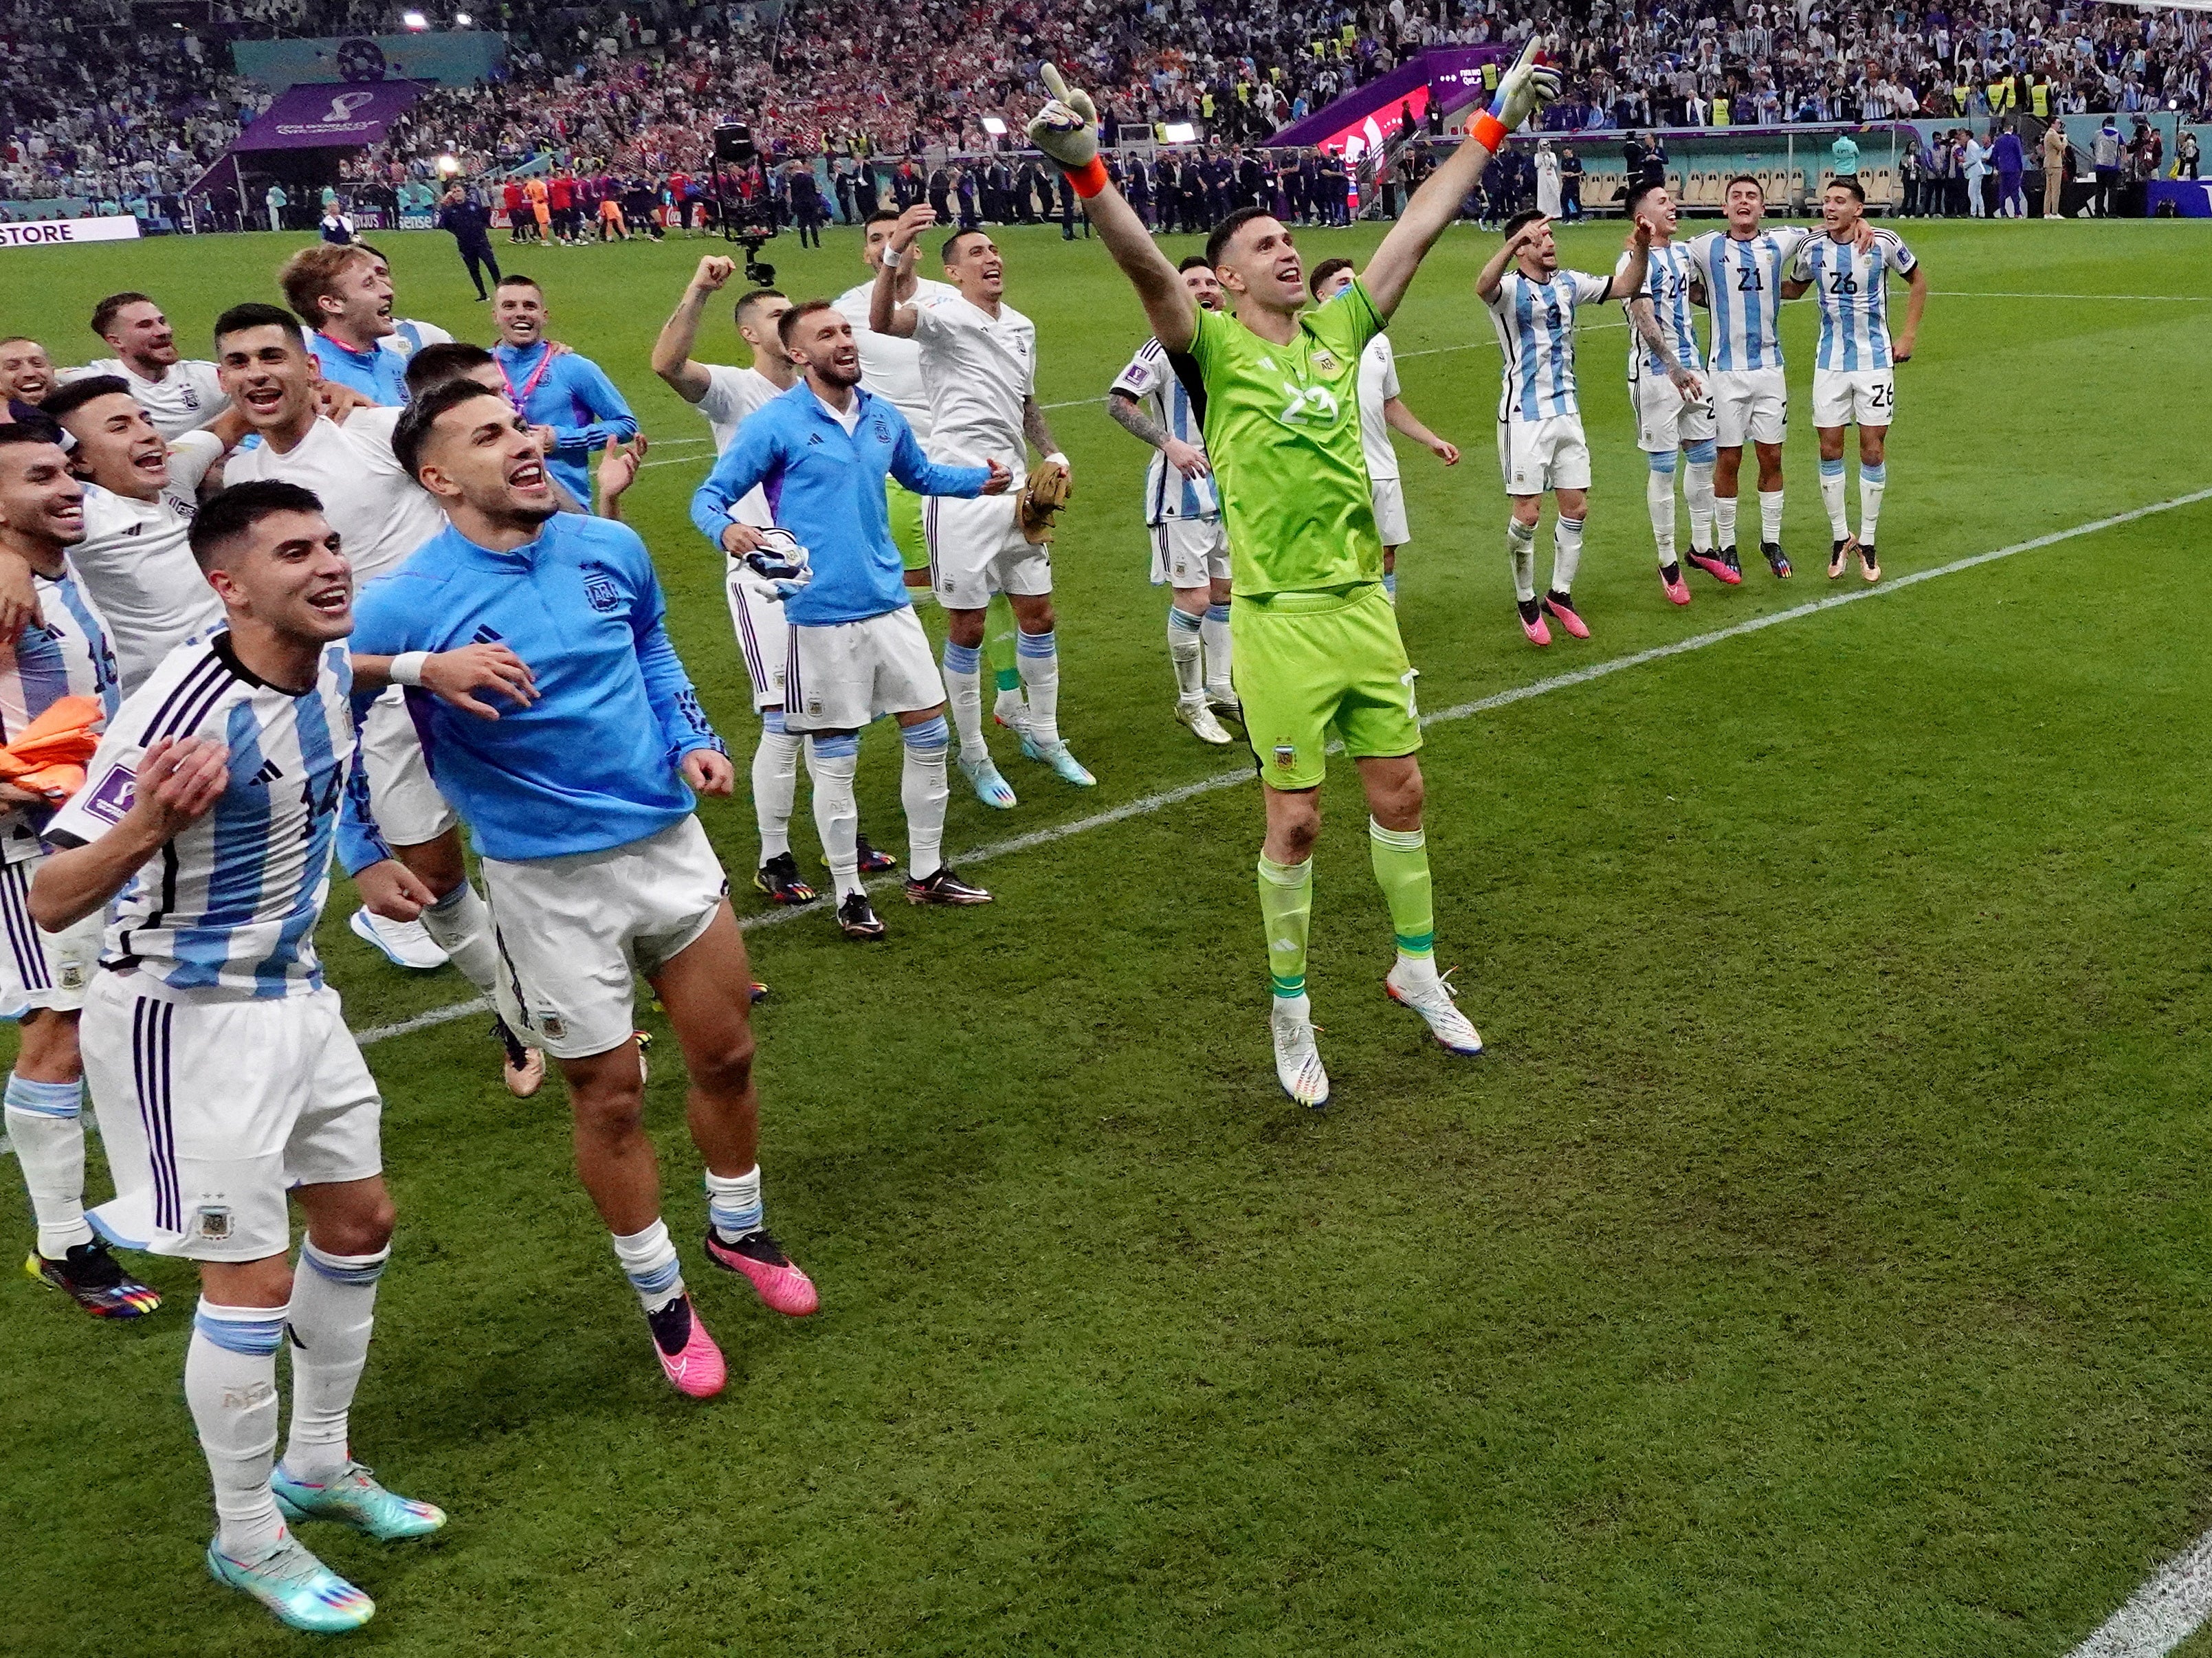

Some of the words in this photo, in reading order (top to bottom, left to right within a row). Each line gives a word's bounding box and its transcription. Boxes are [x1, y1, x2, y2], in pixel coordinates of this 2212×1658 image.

[0, 224, 74, 245] STORE
[1668, 273, 1688, 298] 24
[1736, 267, 1764, 291] 21
[1829, 272, 1858, 294] 26
[300, 760, 343, 840] 14
